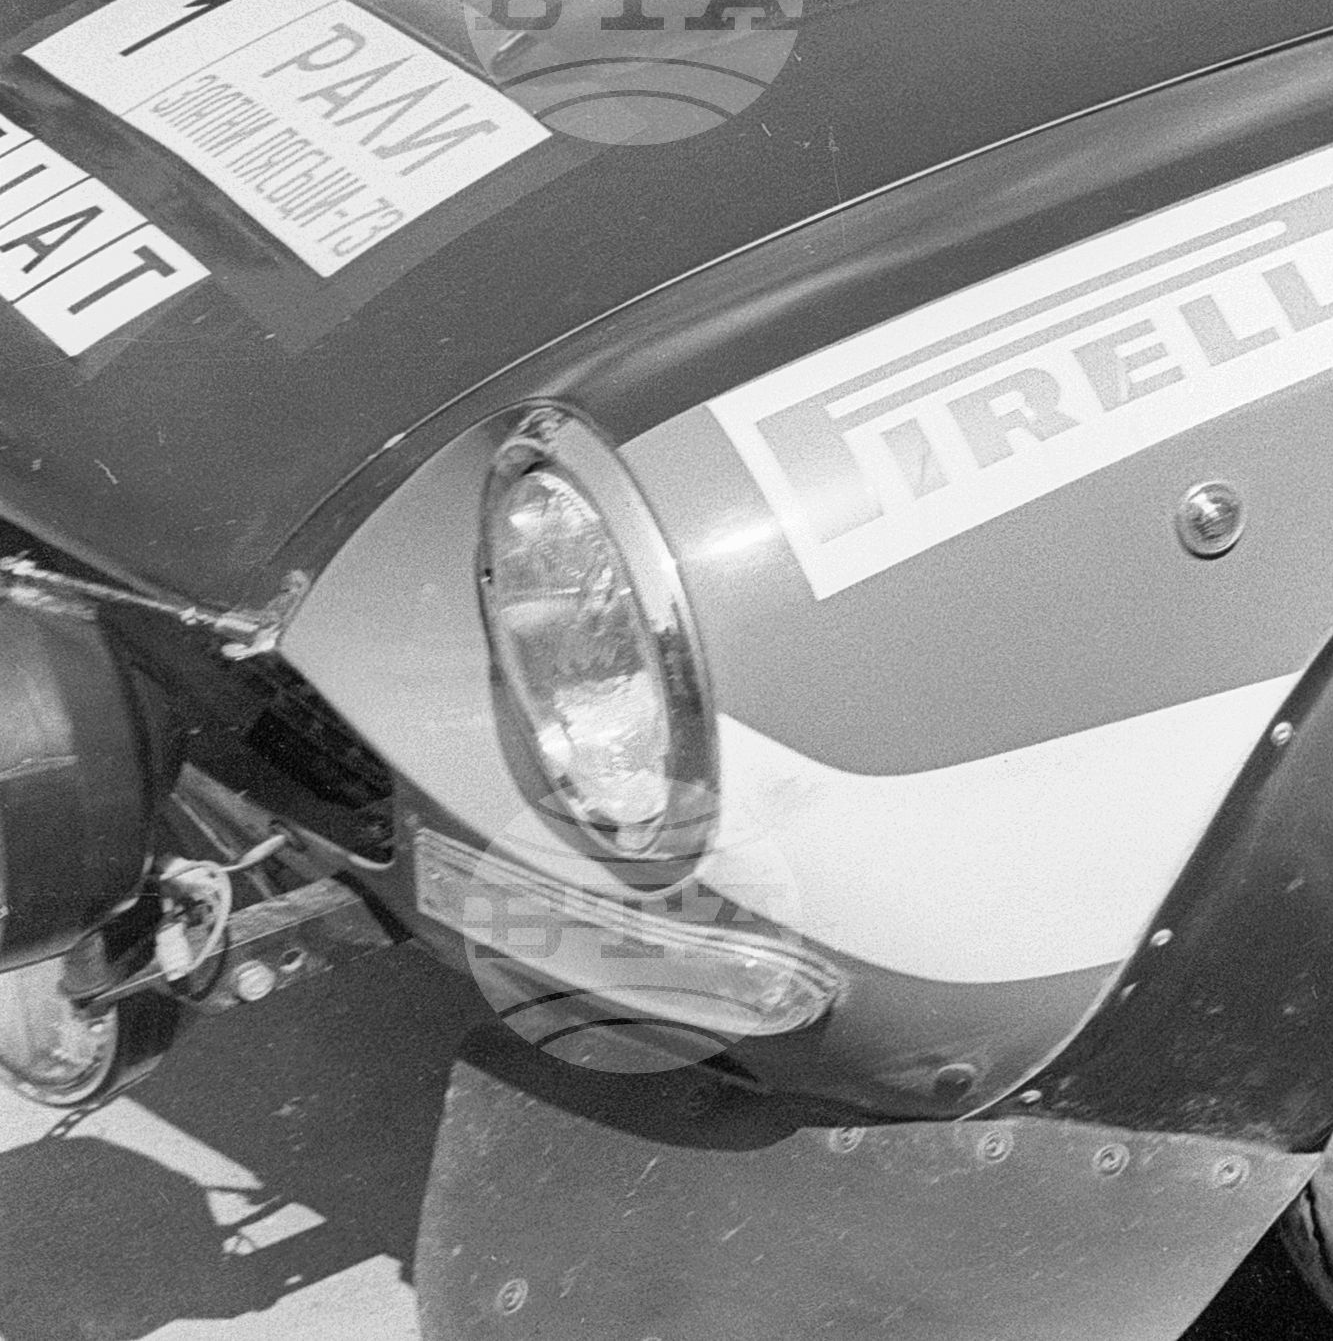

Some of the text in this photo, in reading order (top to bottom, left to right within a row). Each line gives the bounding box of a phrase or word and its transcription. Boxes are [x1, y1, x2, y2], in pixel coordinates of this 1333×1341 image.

[149, 74, 405, 258] ЗЛАТНИ ПЯСЪЦИ-73
[258, 21, 500, 177] РАЛИ
[0, 128, 178, 315] IAT
